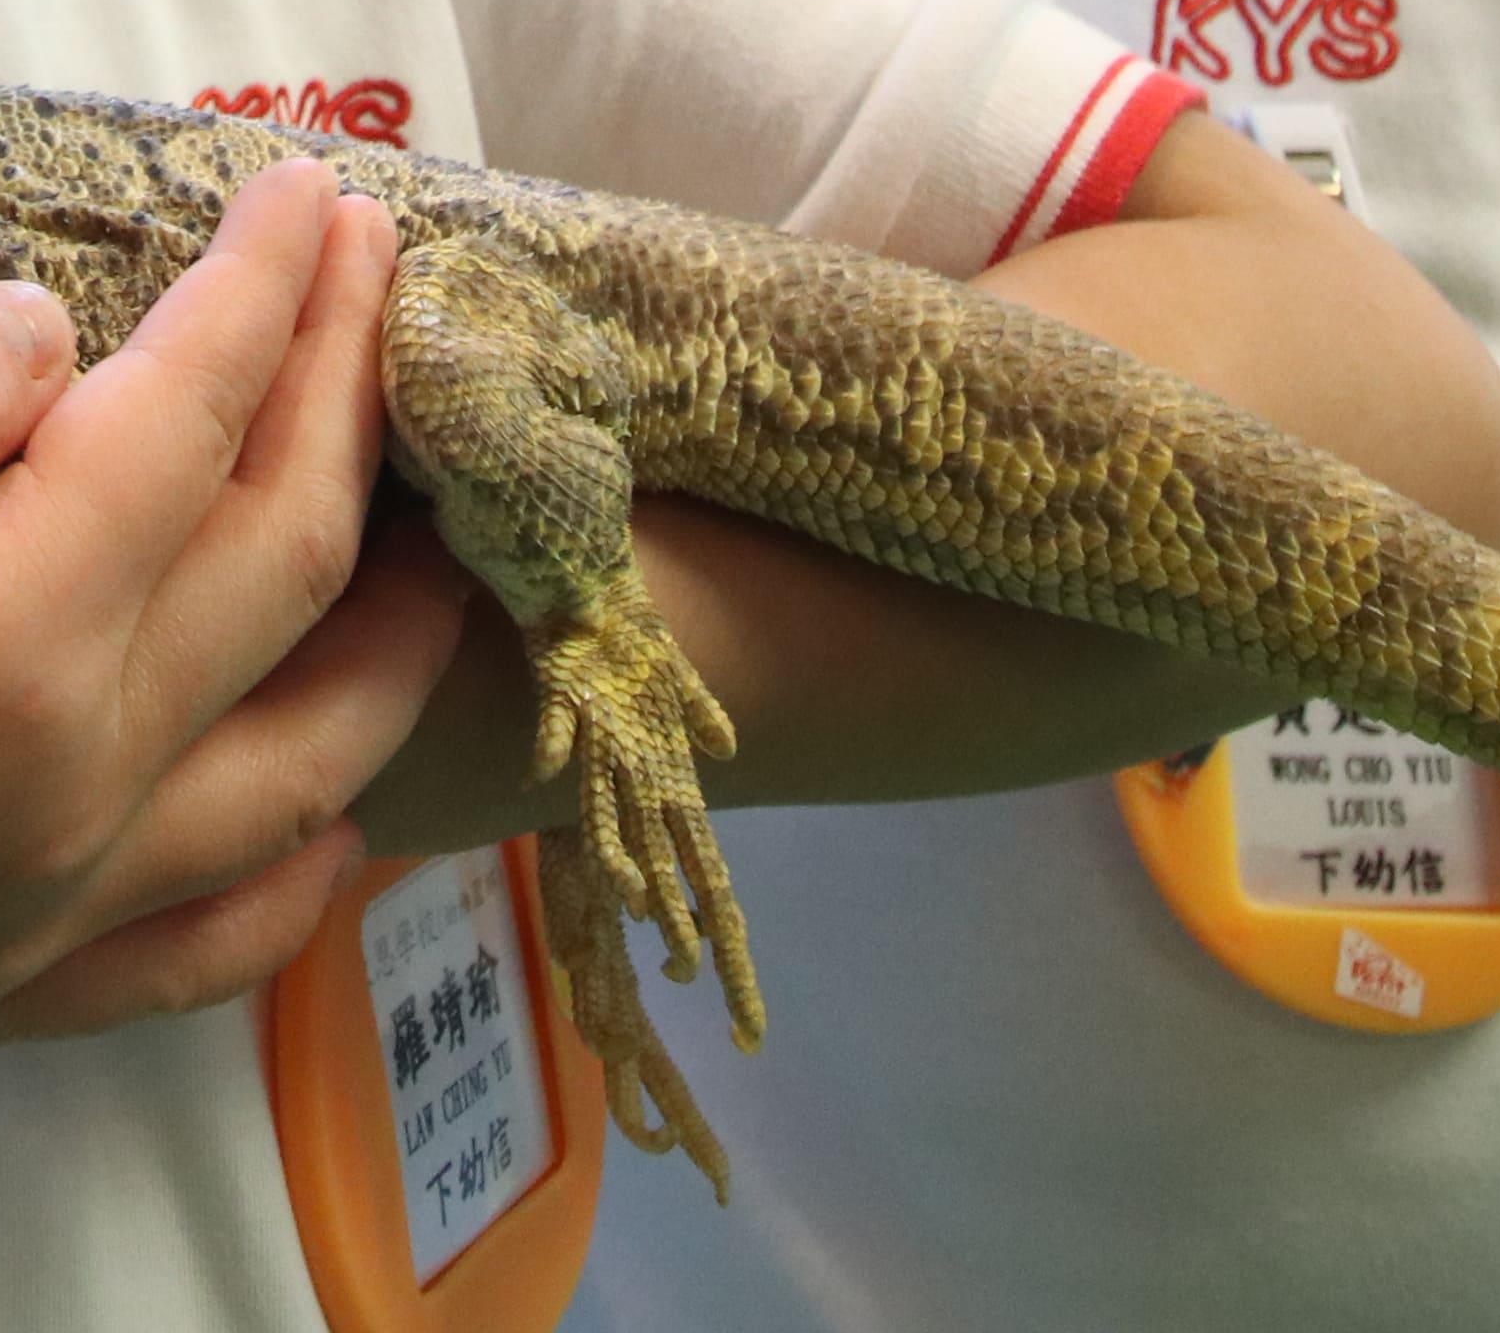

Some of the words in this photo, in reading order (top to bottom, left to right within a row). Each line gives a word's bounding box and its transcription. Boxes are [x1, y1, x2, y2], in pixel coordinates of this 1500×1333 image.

[1268, 754, 1331, 784] WONG
[1344, 754, 1393, 784] CHO
[1404, 754, 1453, 784] YIU
[1326, 796, 1408, 828] LOUIS
[403, 1100, 436, 1158] LAW
[440, 1059, 489, 1126] CHING
[425, 1115, 513, 1229] 下幼信
